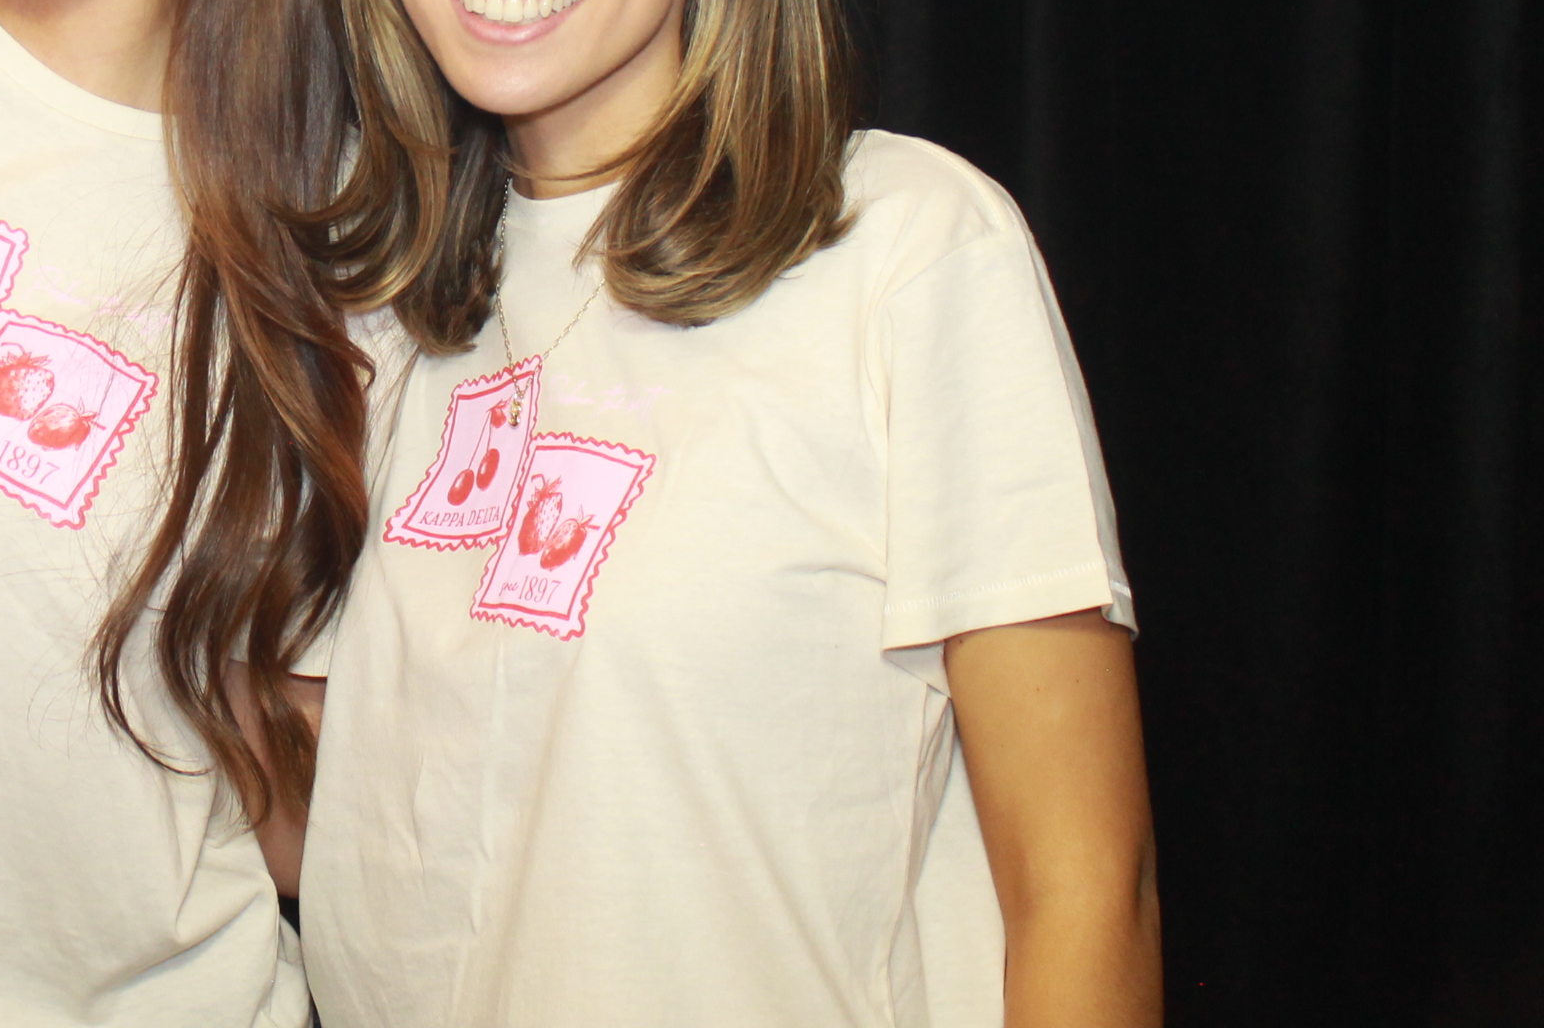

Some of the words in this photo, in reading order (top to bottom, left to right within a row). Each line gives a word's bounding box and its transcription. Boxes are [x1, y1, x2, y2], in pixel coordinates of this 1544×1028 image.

[418, 511, 465, 527] KAPPA
[467, 505, 500, 526] DELTA
[518, 575, 562, 605] 1897
